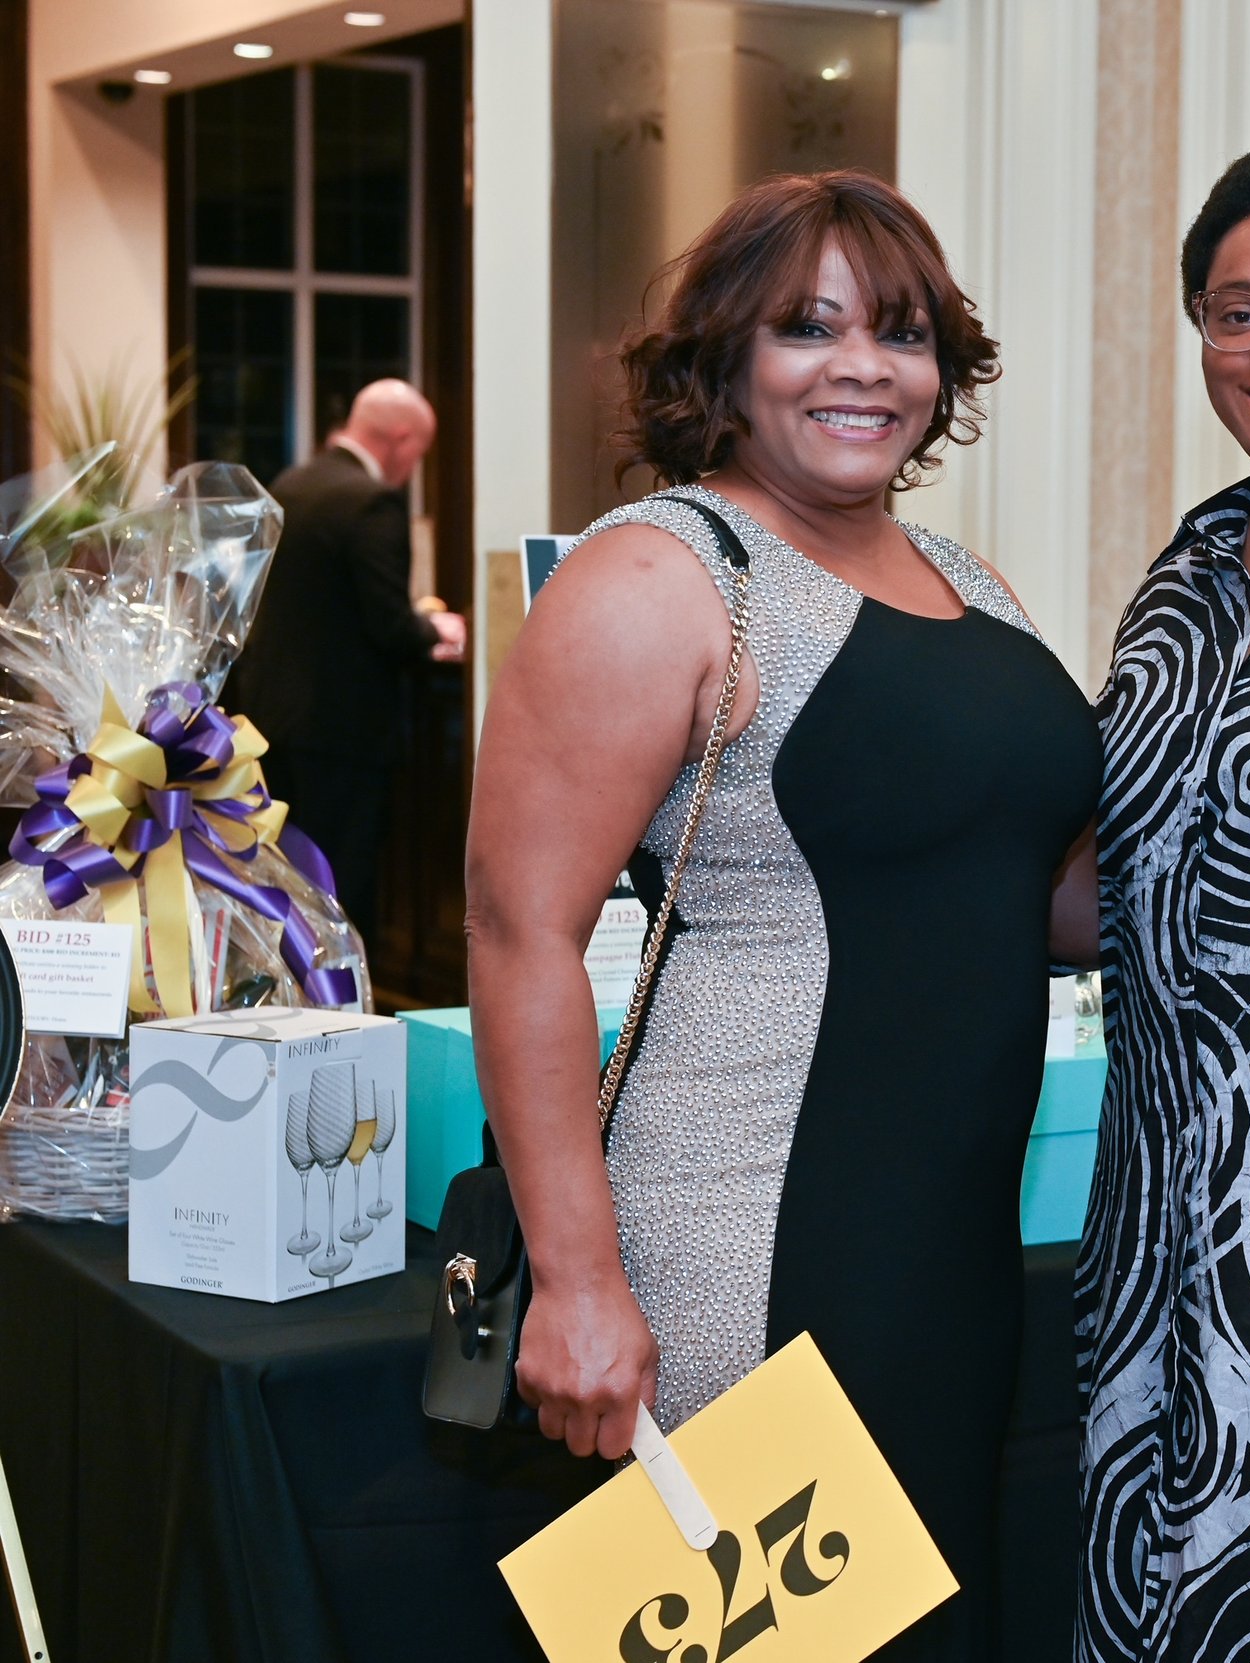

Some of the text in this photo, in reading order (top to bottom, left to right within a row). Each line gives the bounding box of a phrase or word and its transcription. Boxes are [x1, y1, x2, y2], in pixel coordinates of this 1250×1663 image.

[608, 911, 640, 923] #123
[17, 929, 91, 946] BID #125
[28, 973, 47, 981] card
[49, 974, 65, 984] gift
[66, 974, 94, 983] basket
[288, 1037, 341, 1059] INFINITY
[174, 1207, 230, 1226] INFINITY
[180, 1275, 223, 1289] GODINGER
[287, 1280, 317, 1294] GODINGER
[619, 1479, 850, 1663] 273
